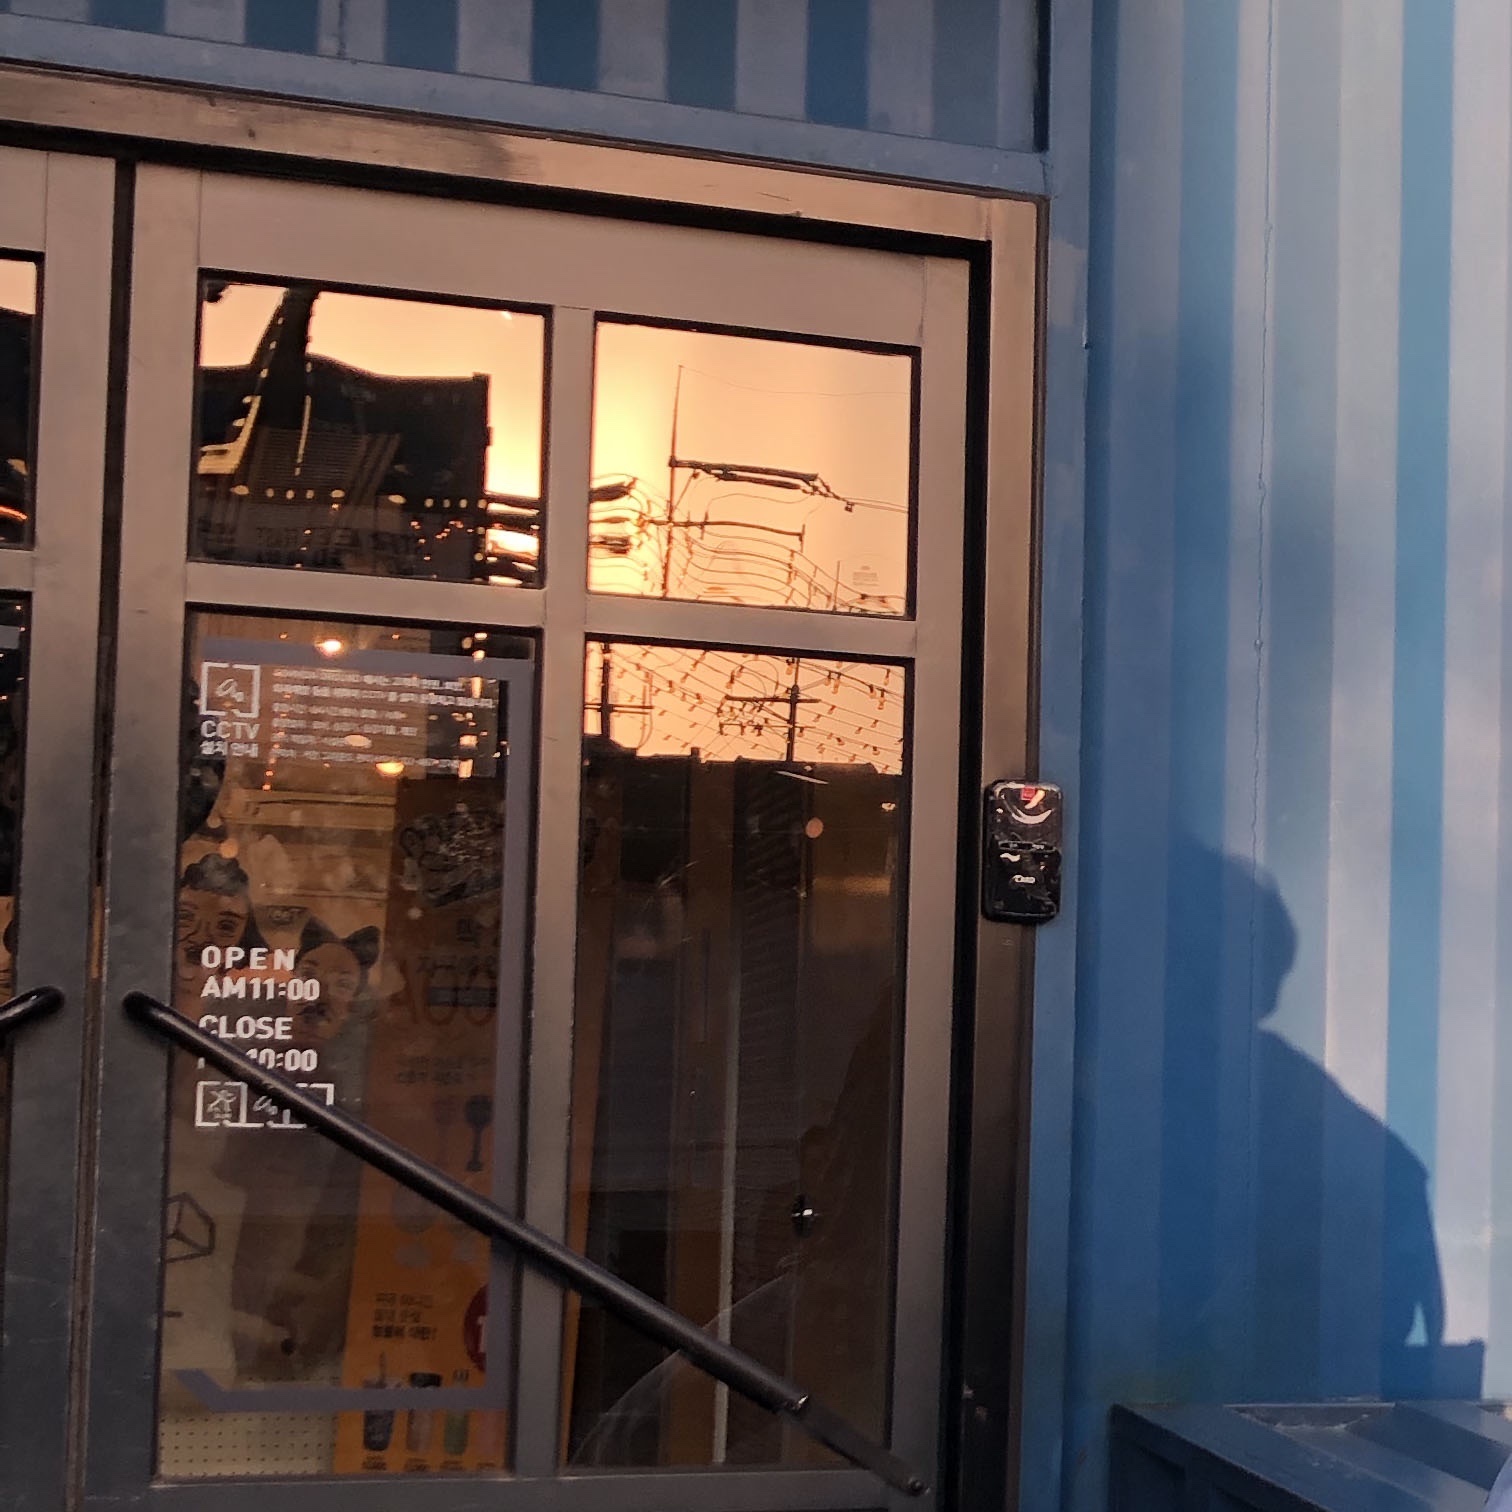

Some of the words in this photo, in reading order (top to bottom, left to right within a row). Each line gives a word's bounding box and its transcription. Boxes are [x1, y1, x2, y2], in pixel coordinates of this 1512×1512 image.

[201, 720, 260, 739] CCTV
[201, 945, 296, 972] OPEN
[200, 975, 321, 1001] AM11:00
[198, 1014, 293, 1040] CLOSE
